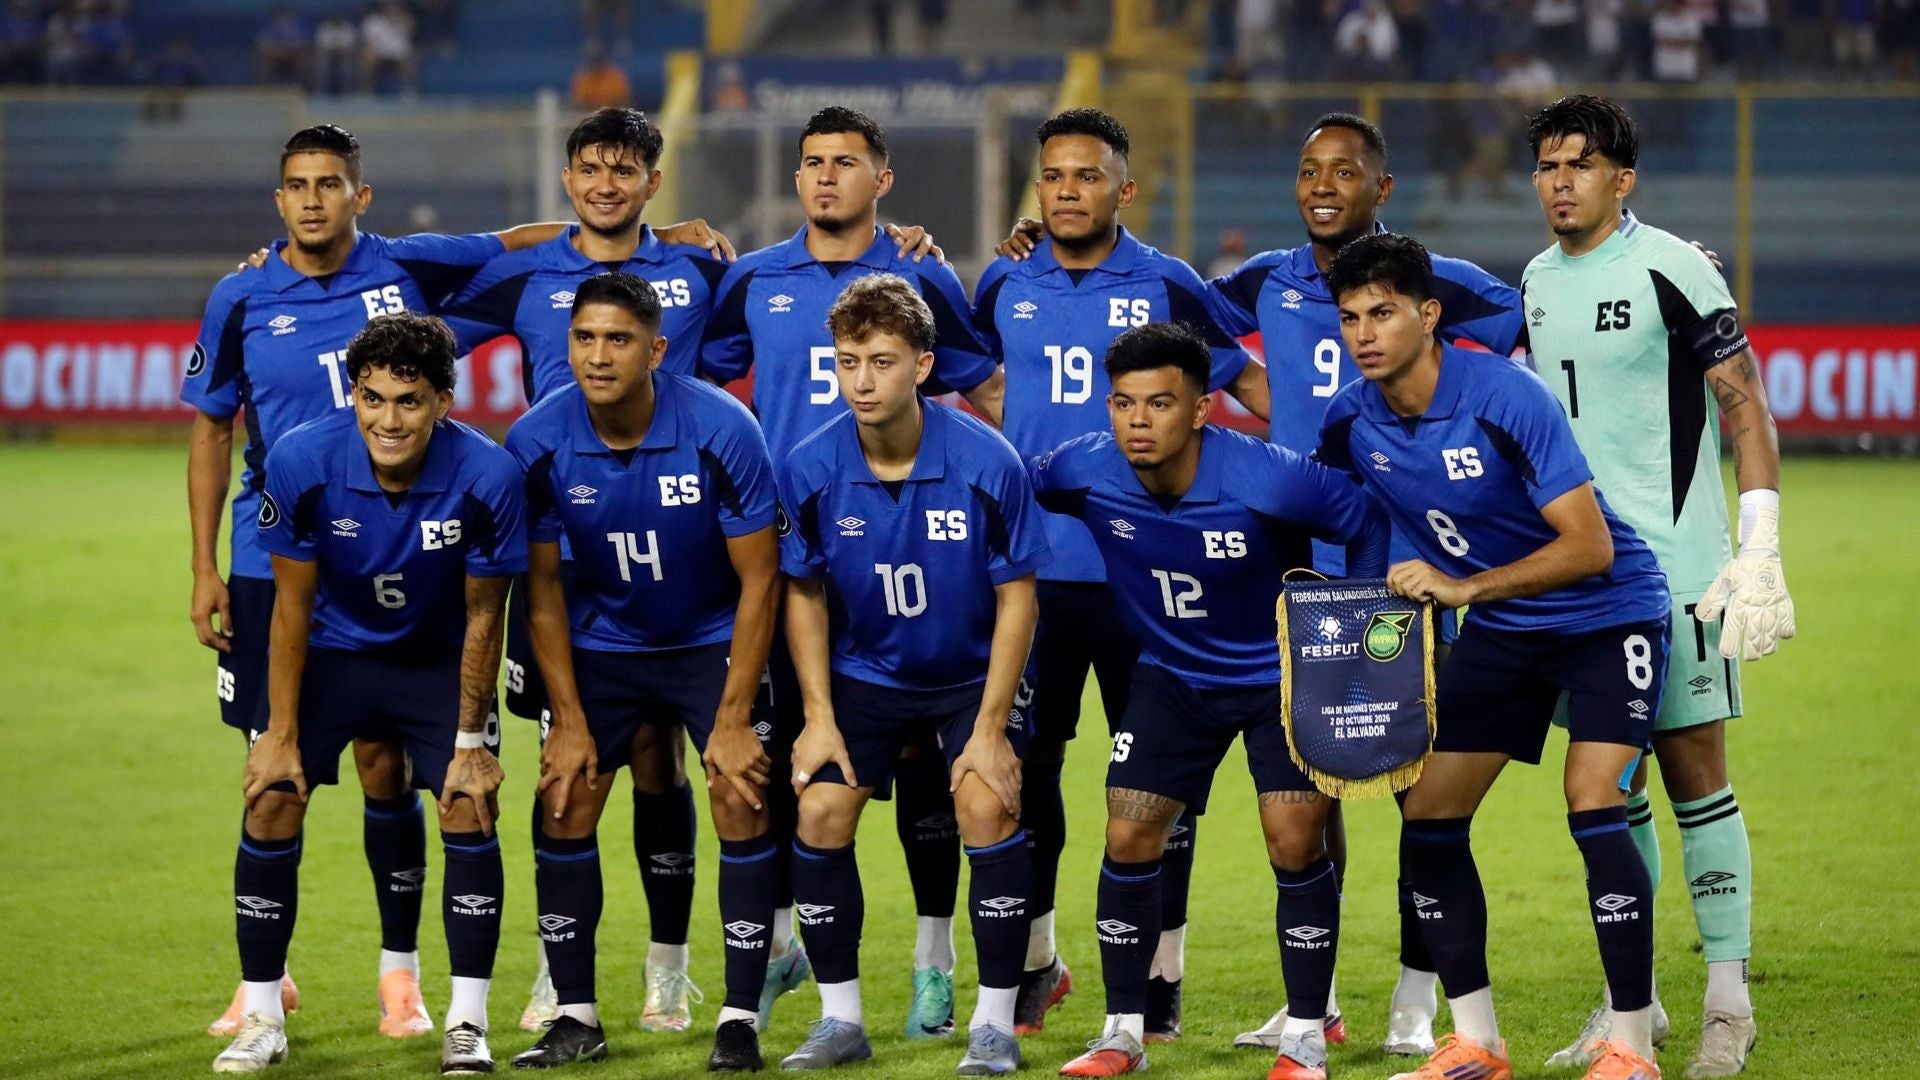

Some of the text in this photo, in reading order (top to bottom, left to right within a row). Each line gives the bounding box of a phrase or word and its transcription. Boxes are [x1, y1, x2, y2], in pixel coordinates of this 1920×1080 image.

[361, 284, 405, 320] ES
[552, 302, 574, 310] umbr
[650, 279, 691, 308] ES
[1108, 298, 1151, 328] ES
[1595, 299, 1631, 332] ES
[2, 343, 184, 410] OCINA
[318, 350, 356, 409] 1
[811, 346, 840, 405] 5
[1044, 345, 1092, 405] 19
[1312, 338, 1341, 398] 9
[1561, 359, 1580, 419] 1
[1764, 350, 1917, 420] OCIN
[1441, 446, 1484, 481] ES
[571, 497, 596, 505] umbro
[658, 473, 702, 507] ES
[333, 529, 357, 539] umbro
[420, 519, 462, 551] ES
[925, 509, 968, 541] ES
[1111, 529, 1134, 541] umbro
[1426, 509, 1470, 558] 8
[606, 530, 664, 582] 14
[1202, 530, 1248, 559] ES
[373, 572, 407, 610] 6
[875, 562, 928, 619] 10
[1151, 568, 1209, 619] 12
[1354, 609, 1367, 620] VS
[1301, 642, 1360, 658] FESFUT
[1623, 634, 1654, 690] 8
[1321, 701, 1399, 715] LIGA DE NACIONES CONCACAF
[1330, 714, 1391, 726] 2 DE OCTUBRE 2026
[1335, 724, 1386, 738] EL SALVADOR
[452, 905, 496, 916] umbro
[798, 916, 835, 926] mbro
[979, 908, 1025, 919] umbro
[1597, 911, 1639, 923] umbro
[541, 931, 576, 943] mbro
[725, 937, 764, 950] umbro
[1285, 939, 1330, 950] umbro
